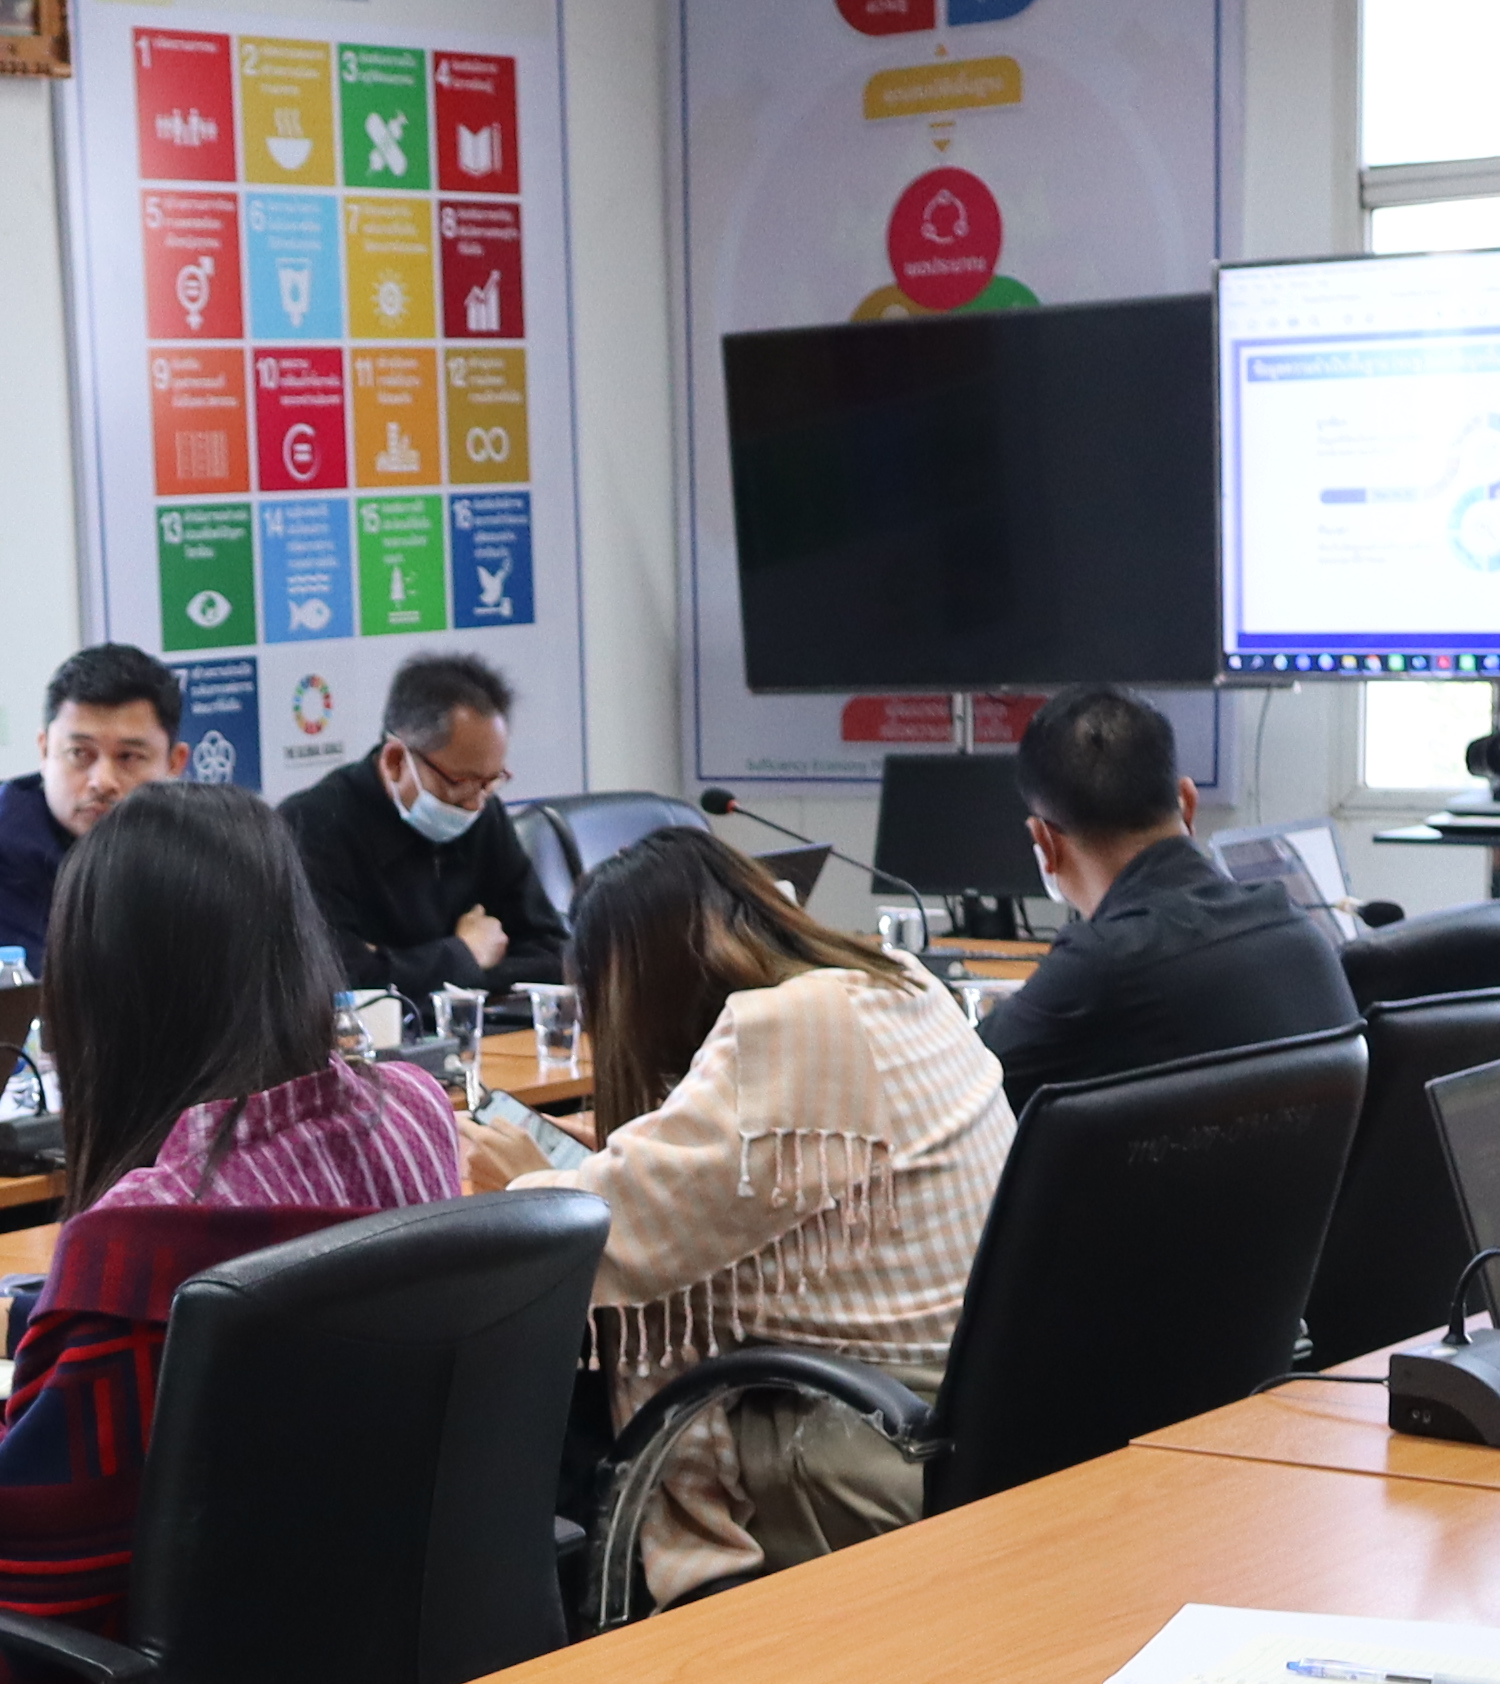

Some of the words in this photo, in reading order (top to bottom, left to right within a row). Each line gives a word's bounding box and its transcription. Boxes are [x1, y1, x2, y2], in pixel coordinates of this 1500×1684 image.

[136, 35, 151, 68] 1
[243, 43, 259, 76] 2
[342, 50, 358, 82] 3
[436, 58, 450, 87] 4
[146, 197, 163, 228] 5
[250, 200, 265, 232] 6
[347, 204, 359, 234] 7
[441, 206, 457, 239] 8
[153, 357, 170, 390] 9
[257, 357, 279, 389] 10
[355, 358, 374, 387] 11
[447, 357, 467, 388] 12
[161, 511, 182, 544] 13
[264, 507, 284, 538] 14
[360, 502, 380, 534] 15
[453, 499, 473, 531] 16
